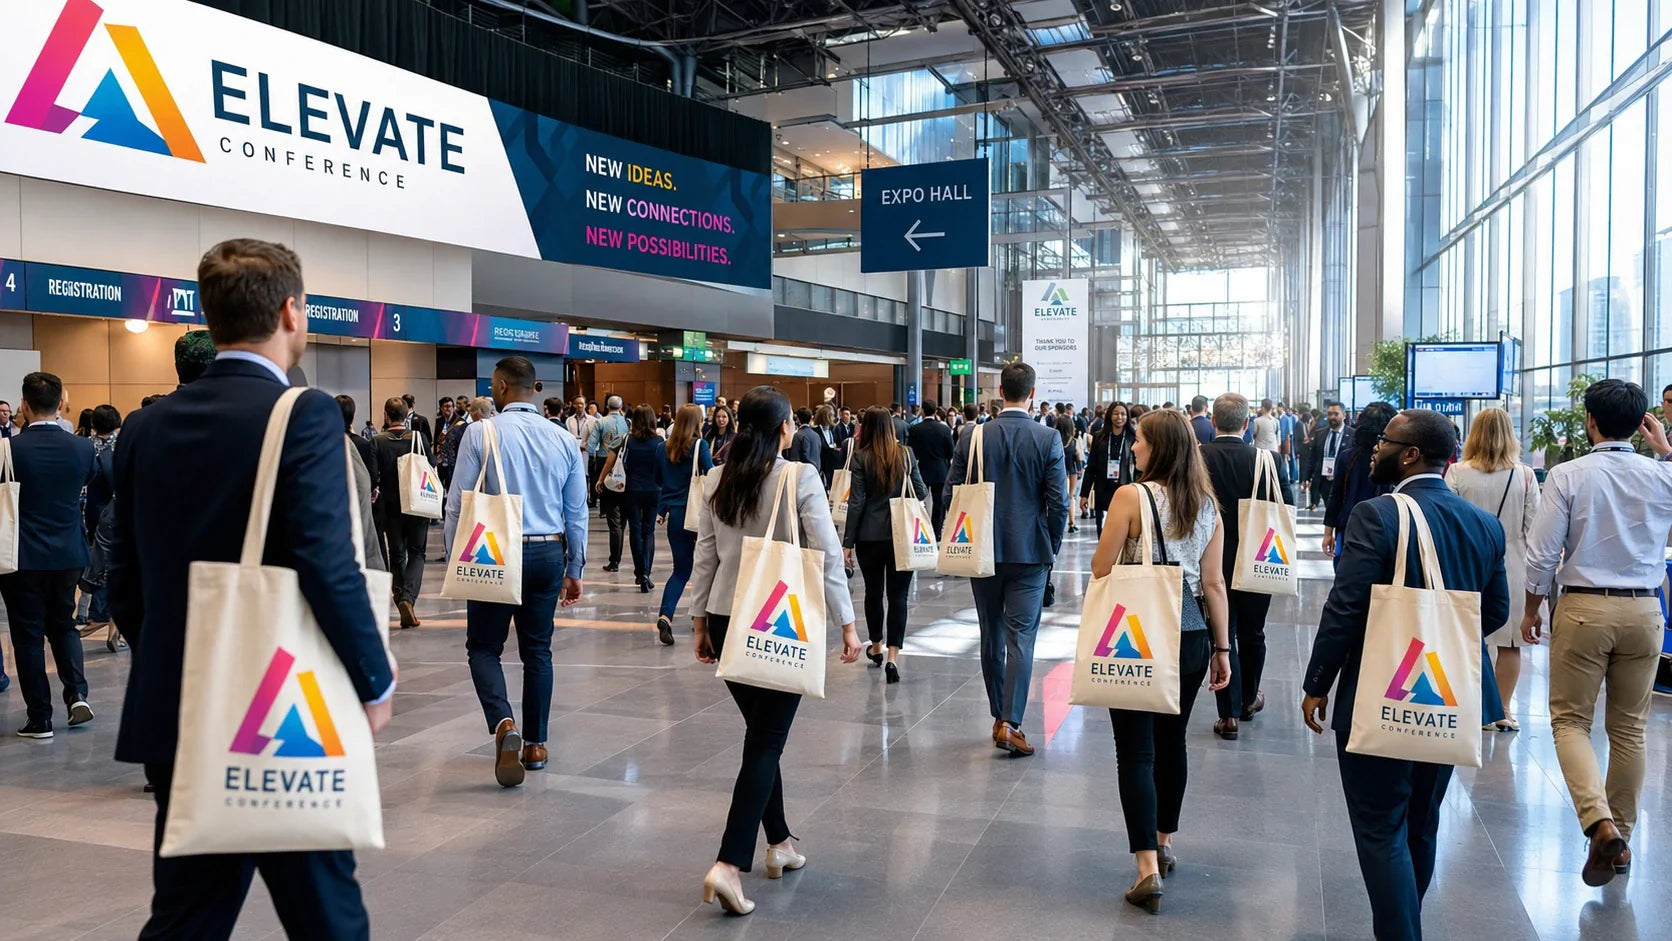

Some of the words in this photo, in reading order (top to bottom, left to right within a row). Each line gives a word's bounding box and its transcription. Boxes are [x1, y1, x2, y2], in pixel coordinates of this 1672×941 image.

[211, 59, 465, 175] ELEVATE
[219, 136, 405, 189] CONFERENCE
[585, 153, 622, 179] NEW
[627, 163, 677, 191] IDEAS.
[881, 187, 925, 205] EXPO
[930, 184, 973, 202] HALL
[585, 189, 622, 214] NEW
[627, 198, 736, 235] CONNECTIONS.
[585, 225, 623, 249] NEW
[627, 233, 732, 266] POSSIBILITIES.
[5, 272, 16, 293] 4
[305, 303, 359, 323] REGISTRATION
[1034, 307, 1077, 316] ELEVATE
[392, 313, 401, 332] 3
[456, 565, 505, 580] ELEVATE
[1253, 564, 1289, 577] ELEVATE
[746, 635, 807, 661] ELEVATE
[745, 651, 804, 669] CONFERENCE
[1091, 662, 1153, 678] ELEVATE
[1091, 677, 1151, 687] CONFERENCE
[1381, 705, 1457, 729] ELEVATE
[1381, 723, 1456, 739] CONFERENCE
[225, 765, 346, 793] ELEVATE
